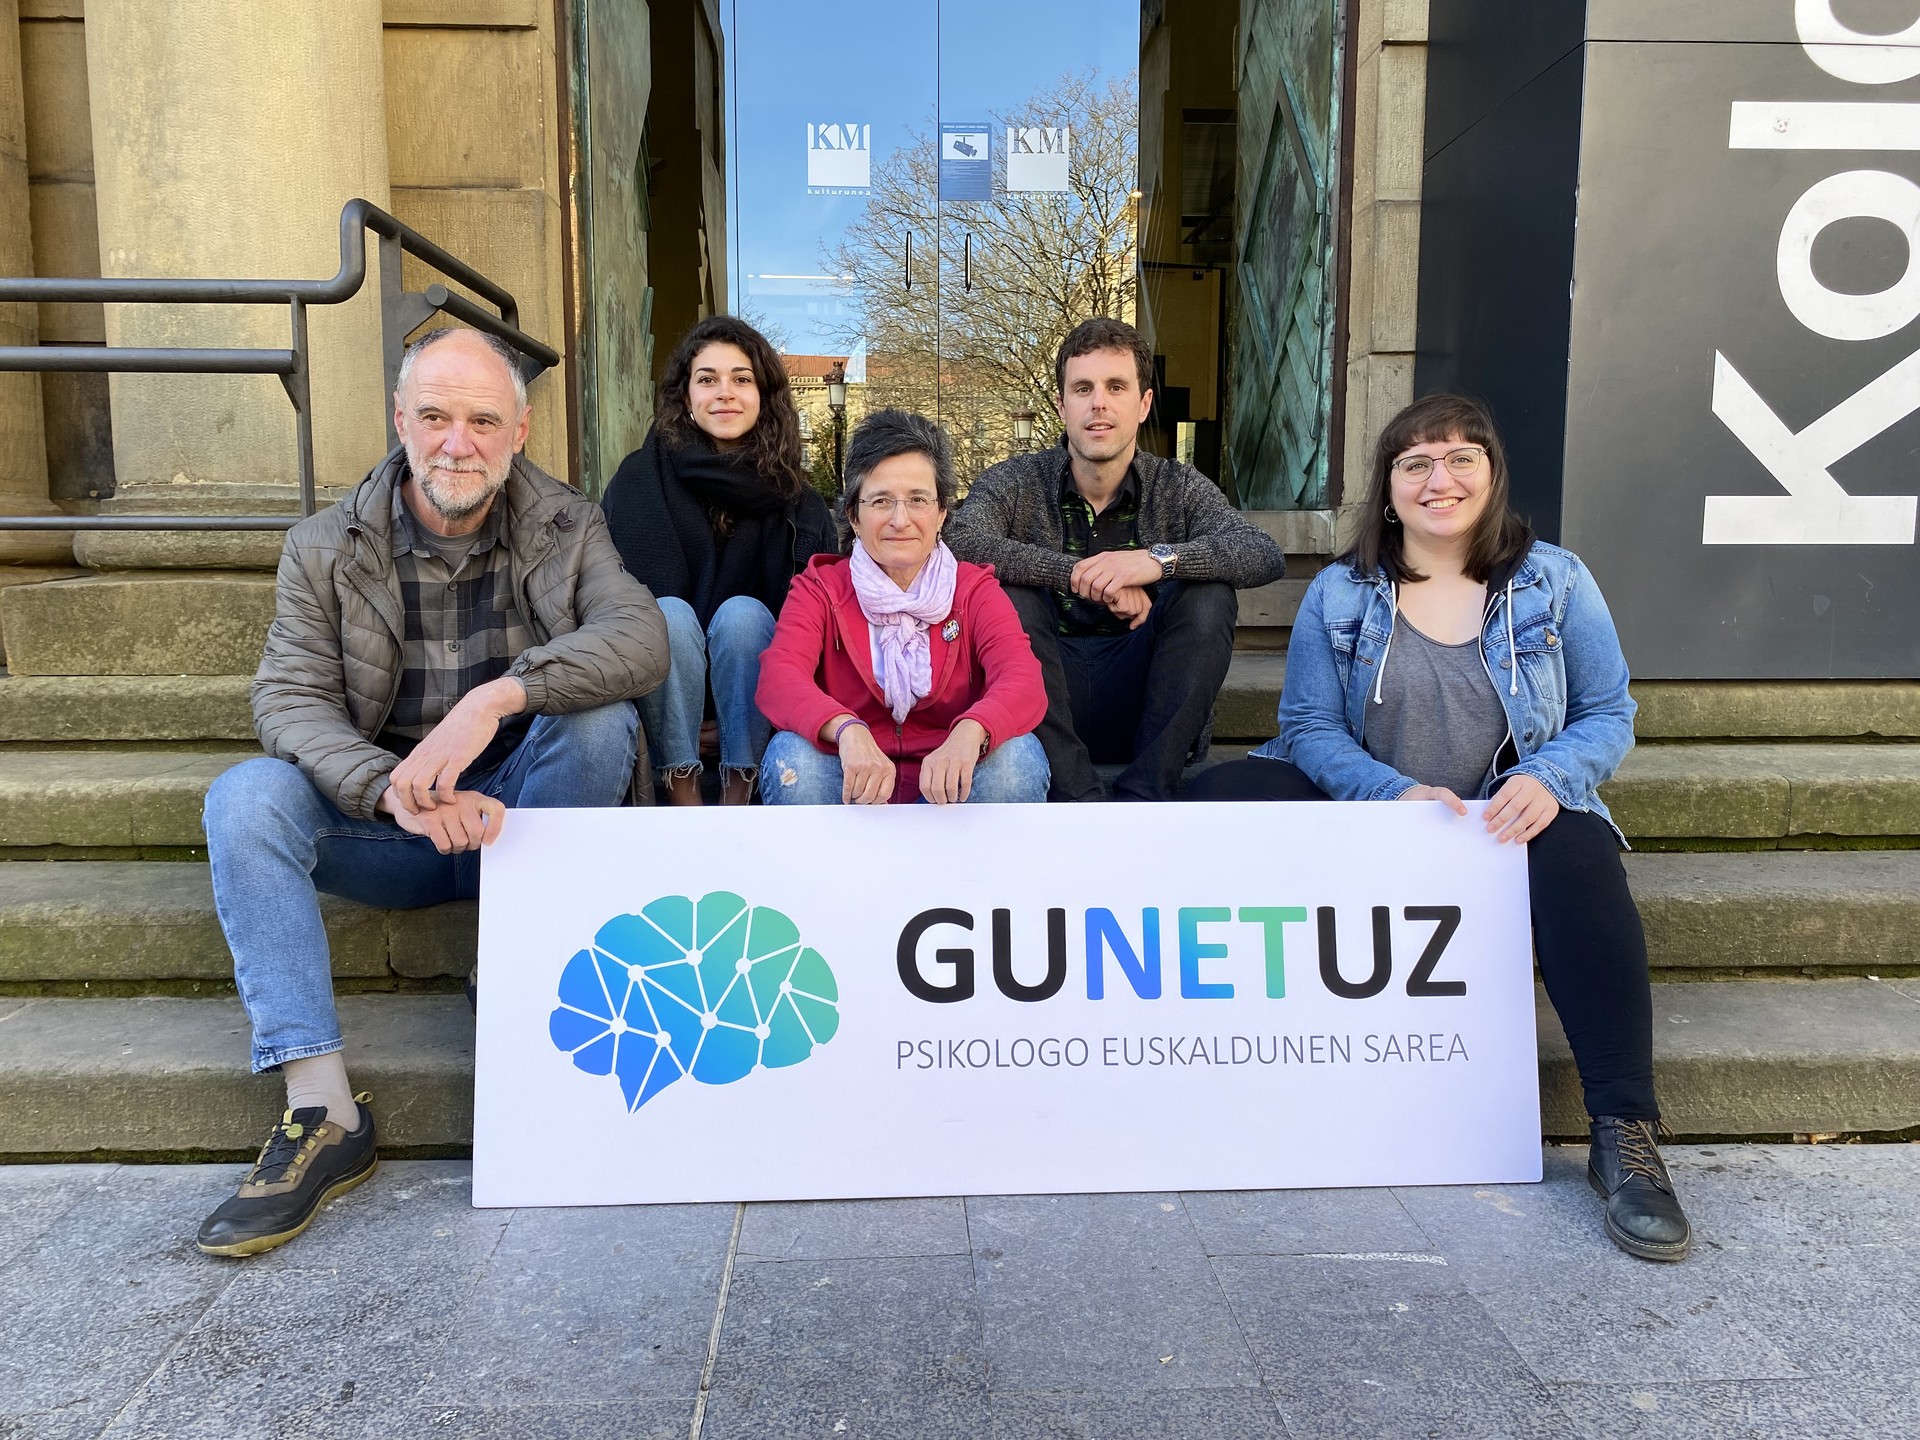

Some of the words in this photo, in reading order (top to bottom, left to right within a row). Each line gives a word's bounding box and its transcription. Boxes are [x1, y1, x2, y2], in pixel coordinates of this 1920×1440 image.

[810, 122, 867, 151] KM
[1010, 126, 1065, 154] KM
[807, 188, 871, 196] kulturunea
[1006, 192, 1069, 201] kulturunea
[896, 905, 1467, 1004] GUNETUZ
[897, 1037, 1089, 1070] PSIKOLOGO
[1102, 1034, 1351, 1067] EUSKALDUNEN
[1363, 1033, 1470, 1063] SAREA
